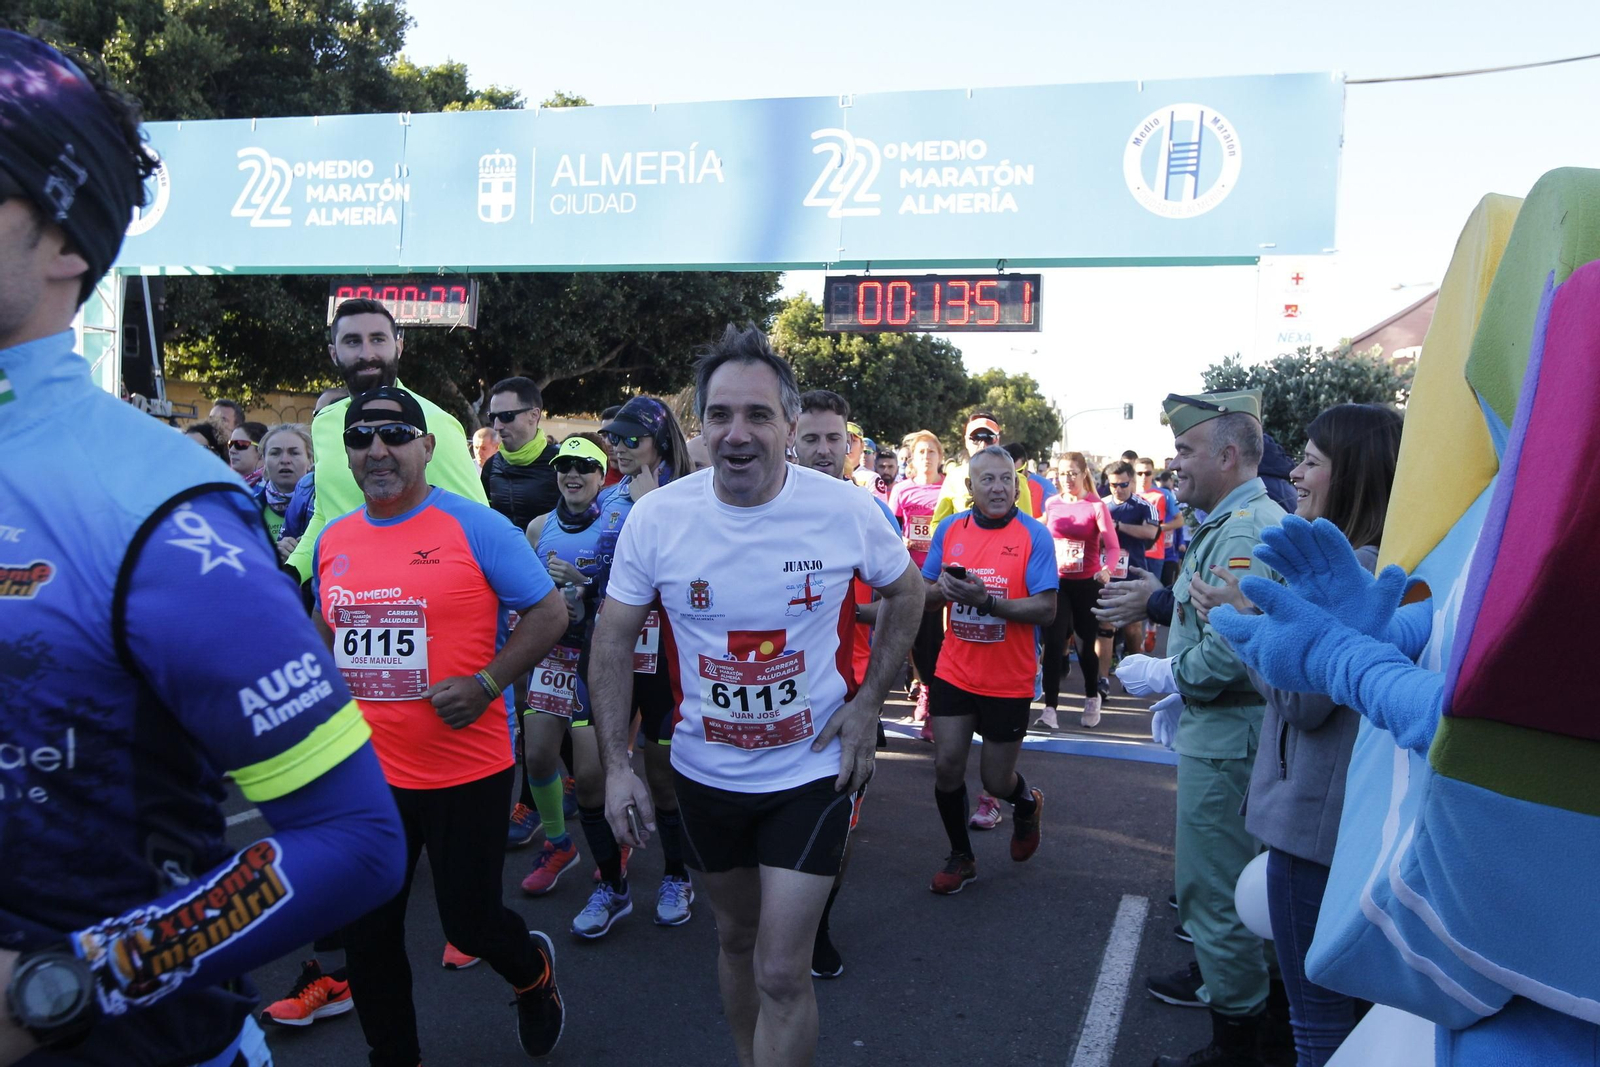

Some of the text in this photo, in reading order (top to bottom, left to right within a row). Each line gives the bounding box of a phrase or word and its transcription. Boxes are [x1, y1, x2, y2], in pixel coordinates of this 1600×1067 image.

[1132, 117, 1160, 147] Medio
[900, 138, 988, 162] MEDIO
[306, 159, 374, 180] MEDIO
[551, 141, 725, 187] ALMERÍA
[899, 159, 1034, 188] MARATÓN
[306, 177, 410, 203] MARATÓN
[898, 186, 1019, 215] ALMERÍA
[305, 201, 398, 226] ALMERÍA
[550, 192, 637, 215] CIUDAD
[858, 281, 1032, 325] 00:13:51
[1277, 332, 1312, 343] NEXA
[783, 560, 823, 572] JUANJO
[981, 575, 1008, 585] RATÓN
[364, 587, 402, 600] MEDIO
[344, 628, 415, 657] 6115
[351, 656, 402, 665] JOSE MANUEL
[756, 664, 800, 681] SALUDABLE
[764, 658, 799, 673] CARRERA
[238, 652, 322, 717] AUGC
[712, 678, 798, 712] 6113
[730, 709, 780, 720] JUAN JOSE
